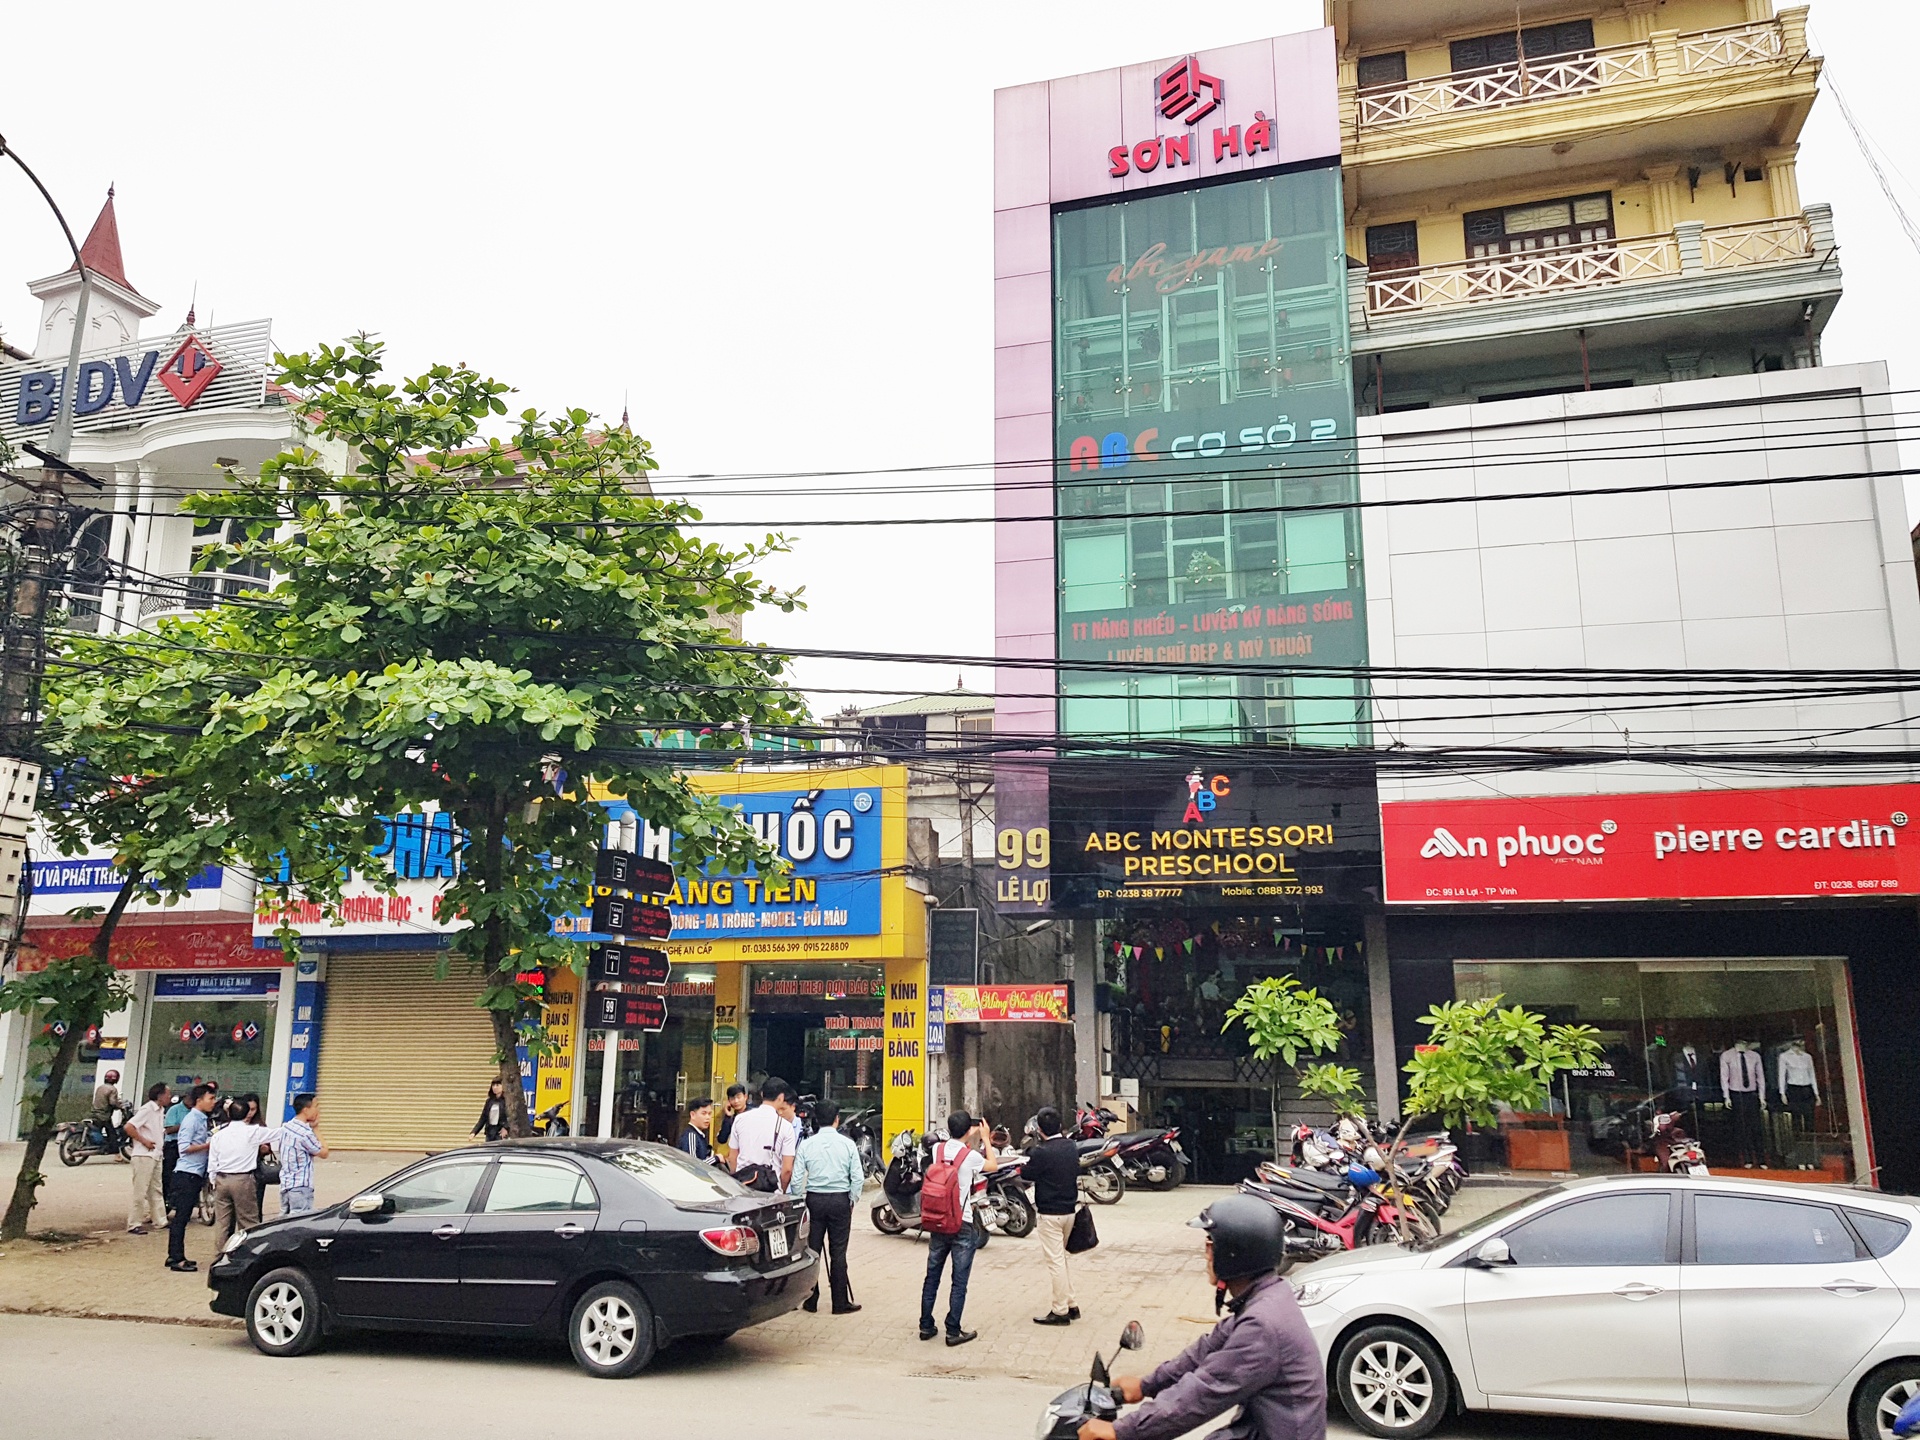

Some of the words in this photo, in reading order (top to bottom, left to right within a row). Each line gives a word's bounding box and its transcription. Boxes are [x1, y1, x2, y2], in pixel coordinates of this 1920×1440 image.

[1109, 134, 1192, 178] SƠN
[1213, 110, 1276, 163] HÀ
[1070, 428, 1159, 472] ABC
[1310, 418, 1338, 444] 2
[1084, 831, 1141, 852] ABC
[1152, 824, 1334, 851] MONTESSORI
[1498, 825, 1605, 868] phuoc
[1655, 824, 1764, 860] pierre
[1775, 819, 1896, 850] cardin
[997, 827, 1050, 870] 99
[616, 868, 623, 878] 3
[1125, 852, 1295, 876] PRESCHOOL
[46, 865, 61, 887] VÀ
[61, 863, 92, 887] PHÁT
[997, 875, 1020, 902] LÊ
[1098, 889, 1113, 898] ĐT:
[1116, 889, 1140, 898] 0238
[1141, 889, 1153, 897] 38
[1222, 887, 1255, 896] Mobile:
[1257, 886, 1283, 895] 0888
[1285, 886, 1303, 895] 372
[1305, 885, 1324, 894] 993
[1426, 888, 1441, 897] ĐC:
[1442, 888, 1453, 896] 99
[1454, 887, 1465, 896] Lê
[1485, 887, 1497, 895] TP
[1500, 887, 1518, 896] Vinh
[1814, 881, 1829, 890] ĐT:
[1857, 880, 1879, 888] 8687
[1881, 879, 1898, 888] 689
[612, 914, 619, 925] 2
[754, 944, 771, 953] 0383
[772, 943, 786, 952] 566
[786, 943, 800, 952] 399
[799, 979, 824, 995] THEO
[890, 979, 918, 1000] KÍNH
[605, 1000, 615, 1013] 99
[715, 1005, 737, 1018] 97
[892, 1006, 916, 1029] MẮT
[828, 1035, 856, 1051] KÍNH
[857, 1034, 884, 1053] HIỆU
[928, 1026, 943, 1044] LOA
[618, 1038, 640, 1052] HOA
[888, 1033, 919, 1058] BẰNG
[892, 1069, 914, 1087] HOA
